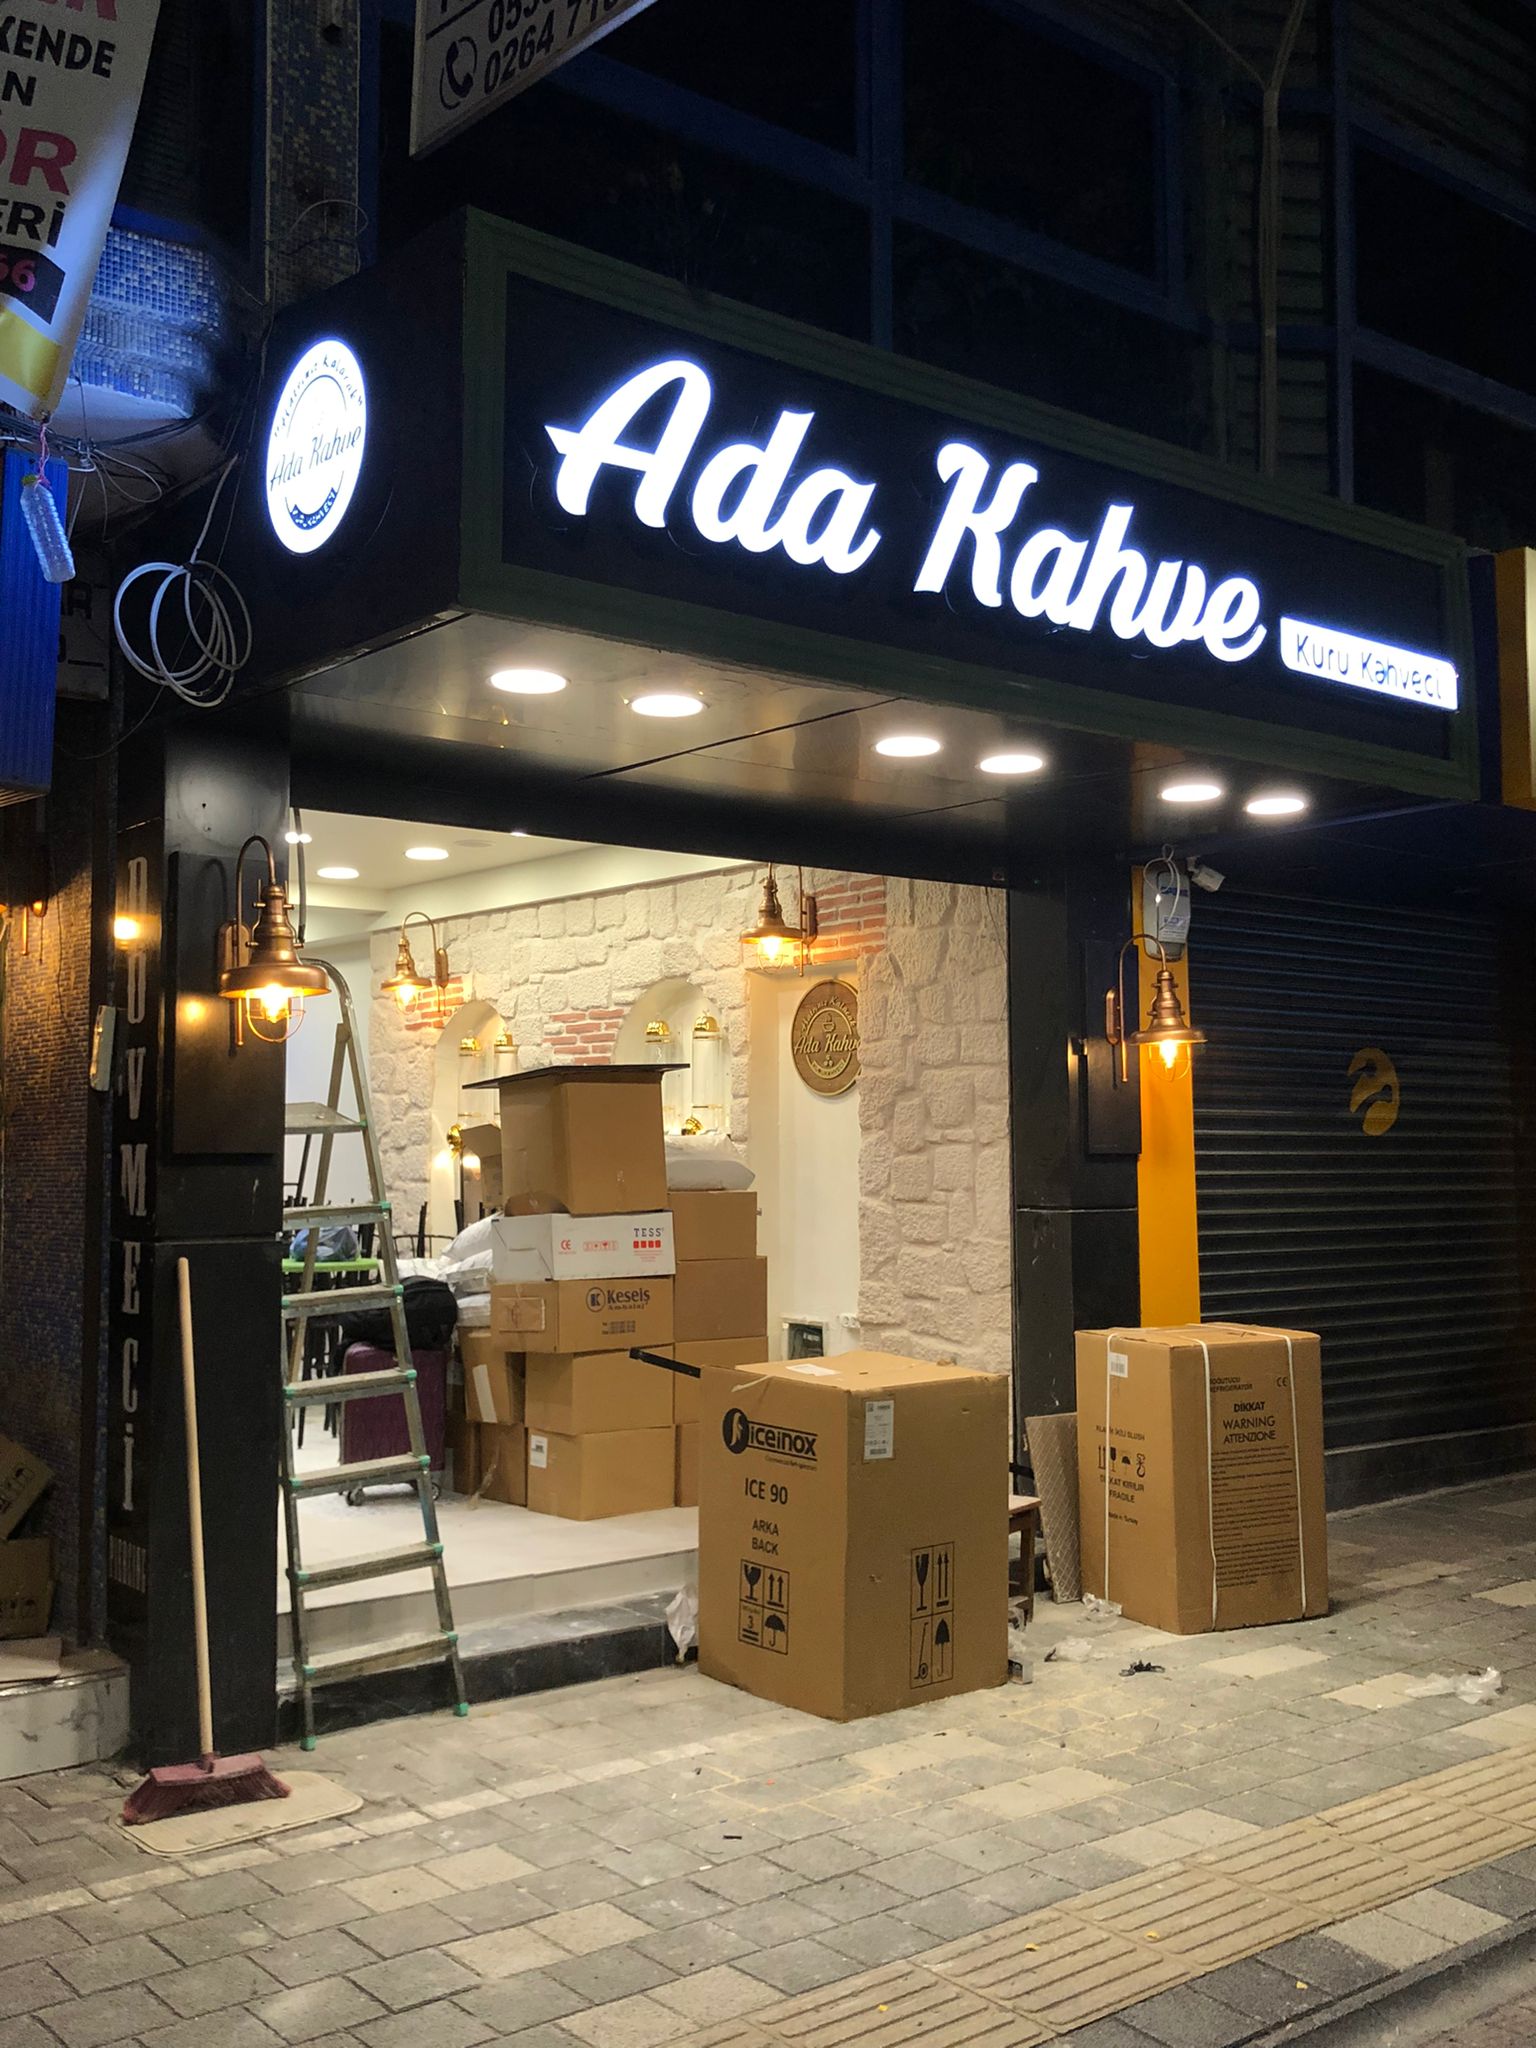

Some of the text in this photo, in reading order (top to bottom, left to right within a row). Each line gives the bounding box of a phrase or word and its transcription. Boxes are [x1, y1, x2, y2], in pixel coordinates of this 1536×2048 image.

[484, 9, 554, 95] 0264
[270, 425, 362, 492] Ada Kahve
[544, 360, 1267, 662] Ada Kahve
[1296, 632, 1442, 700] Kuru Kahveci
[793, 1035, 821, 1055] Ada
[634, 1228, 662, 1238] TESS
[1233, 1400, 1266, 1414] DİKKAT
[1222, 1415, 1276, 1431] WARNING
[750, 1425, 817, 1457] iceinox
[1222, 1430, 1277, 1444] ATTENZIONE
[744, 1477, 788, 1505] ICE 90
[752, 1518, 779, 1537] ARKA
[751, 1537, 779, 1556] BACK
